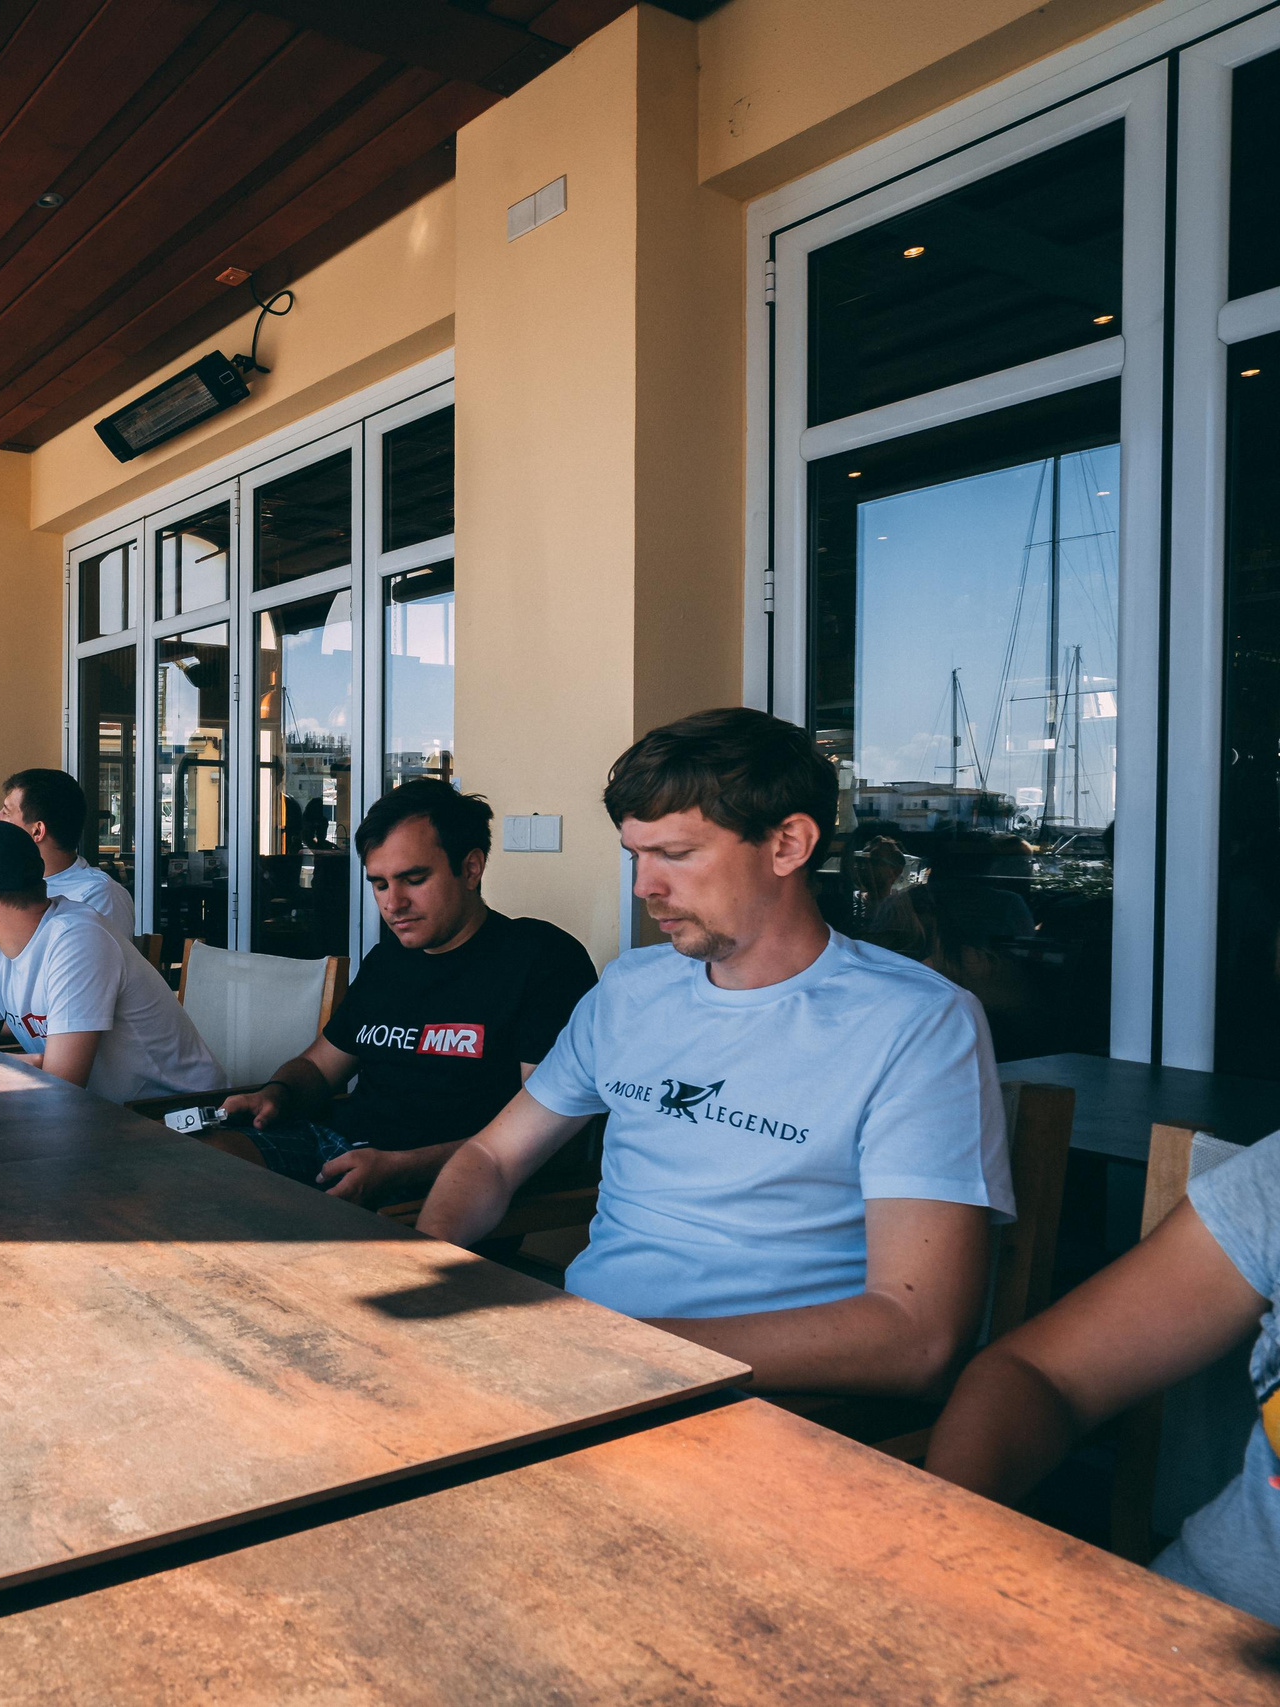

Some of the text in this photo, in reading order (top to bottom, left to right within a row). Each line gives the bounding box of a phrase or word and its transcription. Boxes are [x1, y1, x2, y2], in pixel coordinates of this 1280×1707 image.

[356, 1024, 479, 1054] MORE MMR
[609, 1080, 810, 1145] MORE LEGENDS
